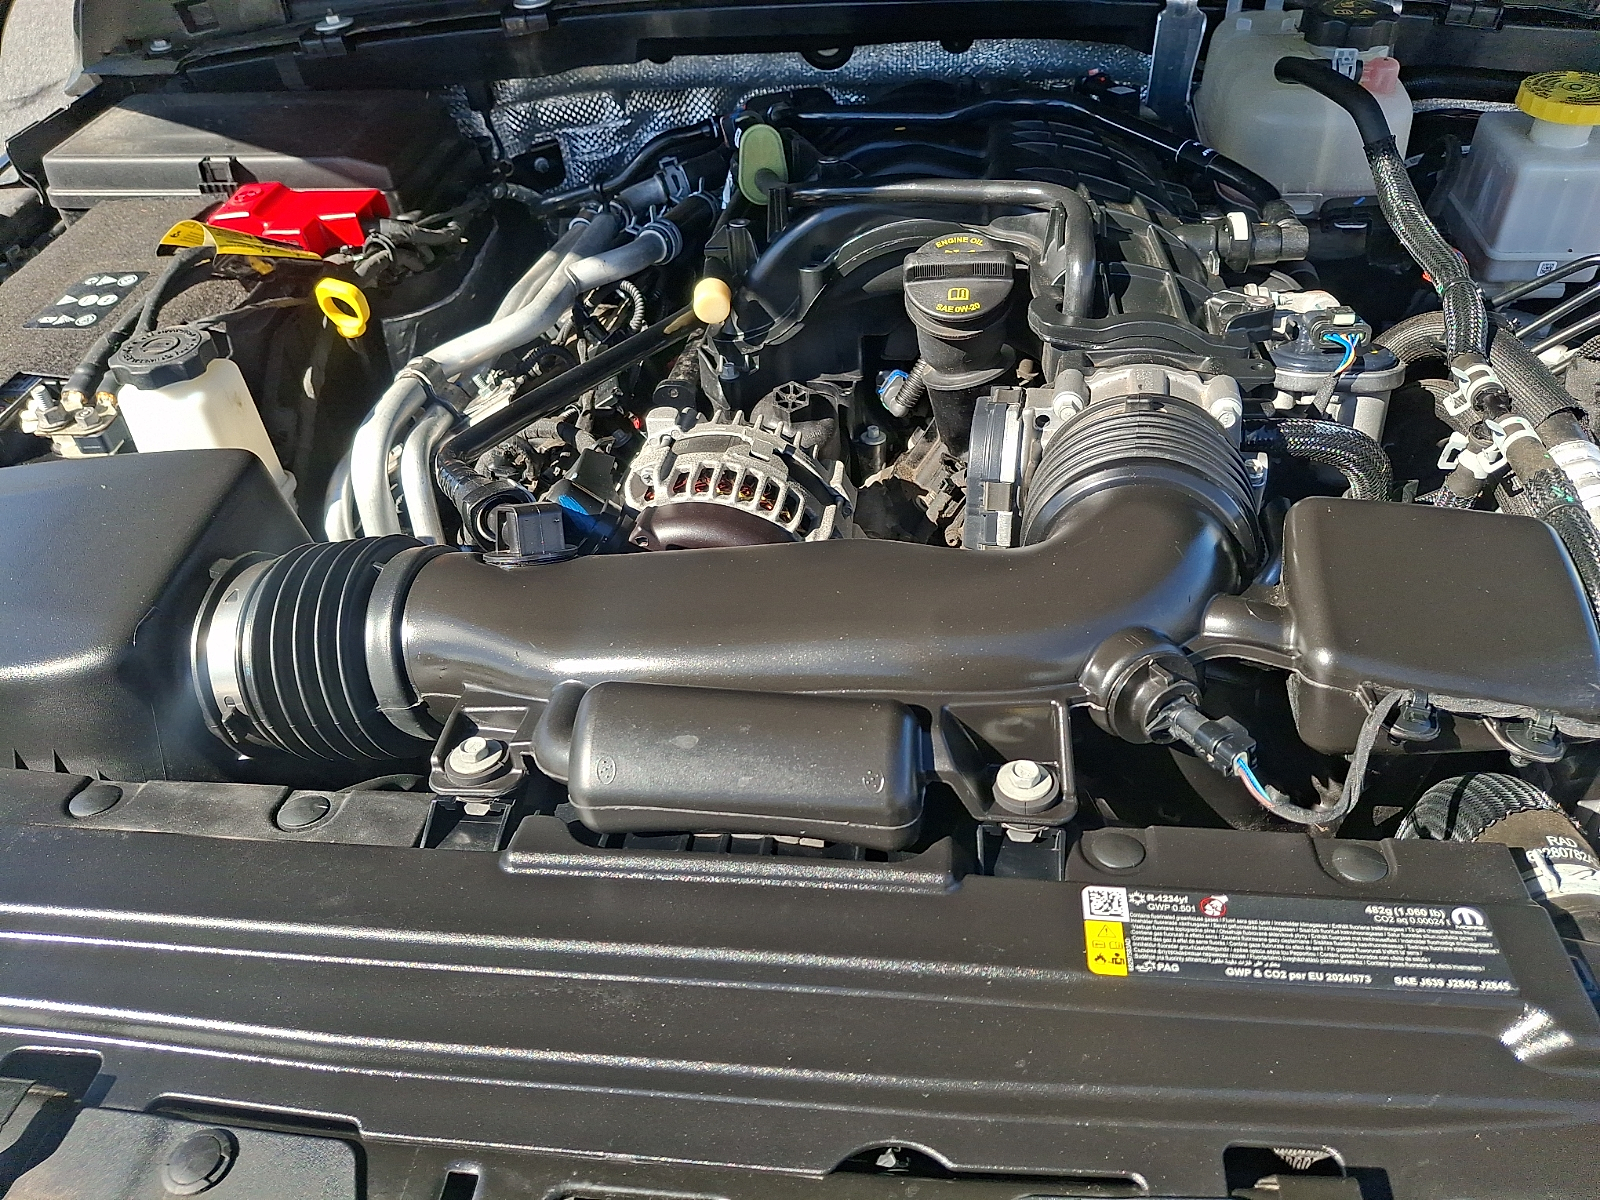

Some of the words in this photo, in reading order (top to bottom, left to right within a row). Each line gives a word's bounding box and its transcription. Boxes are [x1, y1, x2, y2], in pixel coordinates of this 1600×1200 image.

[935, 236, 969, 248] ENGINE
[969, 237, 984, 247] OIL
[935, 303, 954, 313] SAE
[956, 302, 981, 313] 0W-20
[1545, 835, 1578, 848] RAD
[1146, 893, 1188, 905] R-1234yf
[1147, 903, 1171, 911] GWP
[1172, 904, 1196, 913] 0.501
[1364, 904, 1393, 916] 482g
[1429, 908, 1446, 920] lb)
[1373, 914, 1395, 923] CO2
[1156, 962, 1180, 973] PAG
[1225, 966, 1252, 978] GWP
[1253, 968, 1262, 979] &
[1264, 969, 1288, 980] CO2
[1308, 971, 1324, 982] EU
[1325, 972, 1373, 984] 2024/573
[1393, 975, 1418, 986] SAE
